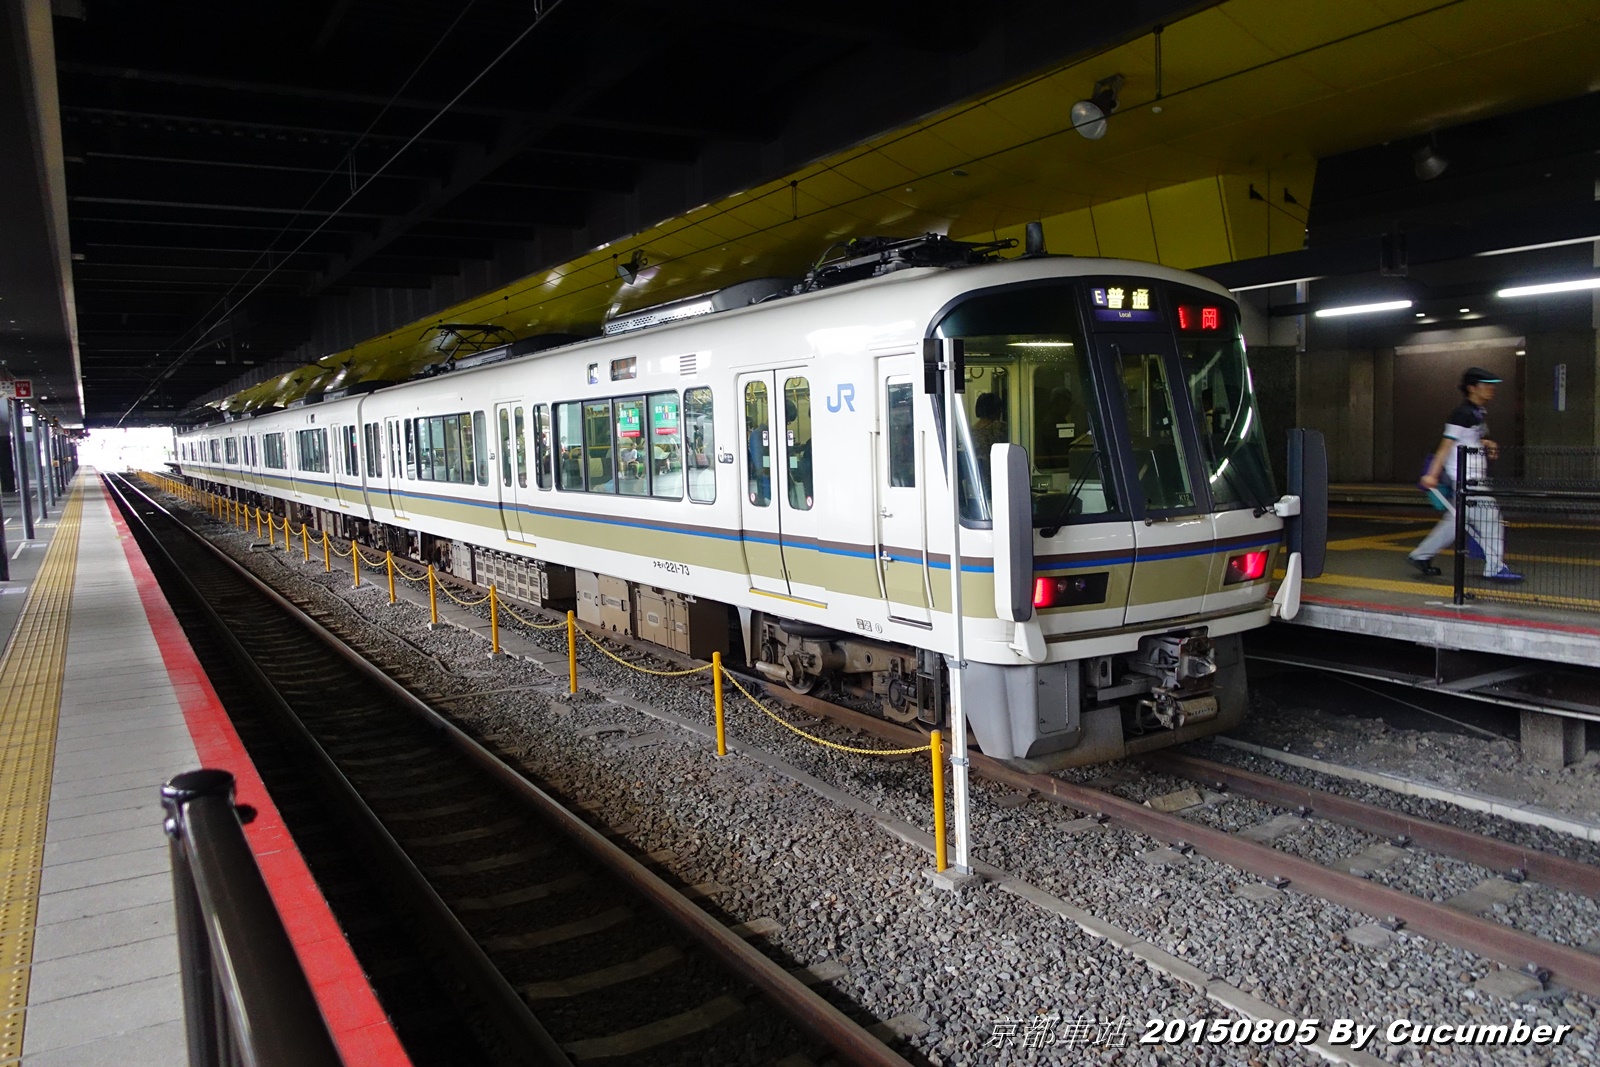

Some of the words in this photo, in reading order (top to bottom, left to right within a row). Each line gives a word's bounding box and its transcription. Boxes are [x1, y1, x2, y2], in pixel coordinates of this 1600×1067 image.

[1094, 290, 1103, 304] E
[1107, 287, 1149, 309] 普通
[826, 383, 856, 413] JR
